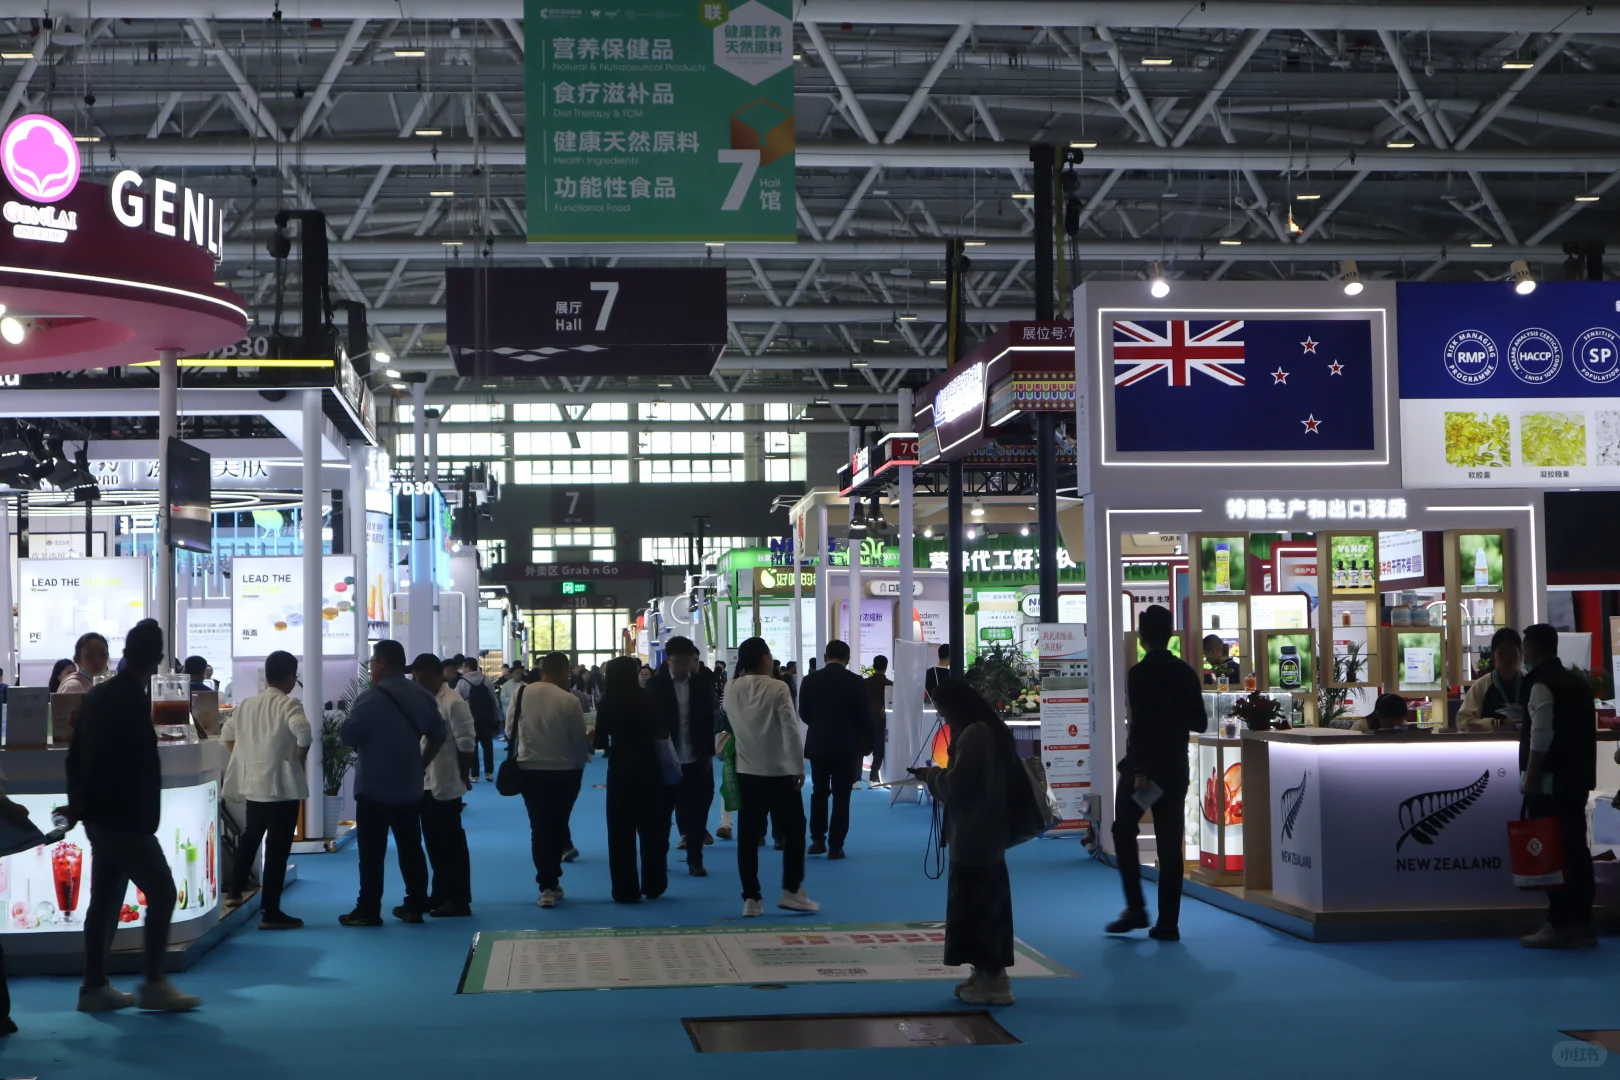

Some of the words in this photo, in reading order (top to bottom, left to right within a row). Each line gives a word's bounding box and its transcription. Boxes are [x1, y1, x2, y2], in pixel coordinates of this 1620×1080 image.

[703, 4, 722, 21] 联
[724, 24, 783, 39] 健康营养
[552, 37, 674, 61] 营养保健品
[724, 40, 783, 55] 天然原料
[552, 62, 588, 72] Natural
[599, 62, 663, 72] Nutraceutical
[664, 63, 706, 72] Products
[552, 81, 675, 105] 食疗滋补品
[553, 109, 573, 118] Diet
[574, 109, 611, 120] Therapy
[622, 109, 644, 118] TCM
[552, 129, 700, 154] 健康天然原料
[553, 155, 585, 165] Health
[586, 155, 639, 167] Ingredients
[717, 149, 761, 211] 7
[759, 178, 781, 188] Hall
[553, 176, 677, 200] 功能性食品
[759, 189, 782, 211] 馆
[554, 203, 605, 213] Functional
[606, 203, 631, 213] Food
[554, 301, 583, 315] 展厅
[589, 281, 620, 332] 7
[555, 318, 583, 331] Hall
[1583, 330, 1616, 341] SENSITIVE
[1446, 339, 1459, 358] RISK
[1458, 332, 1497, 358] MANAGING
[1457, 351, 1486, 363] RMP
[1519, 351, 1552, 361] HACCP
[1589, 348, 1611, 363] SP
[1448, 364, 1495, 383] PROGRAMME
[1581, 367, 1620, 381] POPULATION
[1467, 471, 1491, 479] 软胶囊
[391, 481, 434, 496] 7D30
[565, 491, 580, 515] 7
[524, 565, 559, 577] 外卖区
[560, 565, 590, 576] Grab
[592, 567, 600, 575] n
[602, 565, 619, 576] Go
[31, 578, 58, 587] LEAD
[60, 578, 80, 587] THE
[83, 577, 123, 587] FUTURE
[242, 574, 269, 583] LEAD
[271, 574, 292, 583] THE
[242, 585, 281, 594] FUTURE
[575, 597, 587, 608] 10
[29, 632, 42, 640] PE
[1281, 850, 1294, 864] NEW
[1292, 853, 1312, 869] ZEALAND
[1396, 858, 1431, 872] NEW
[1433, 856, 1502, 871] ZEALAND
